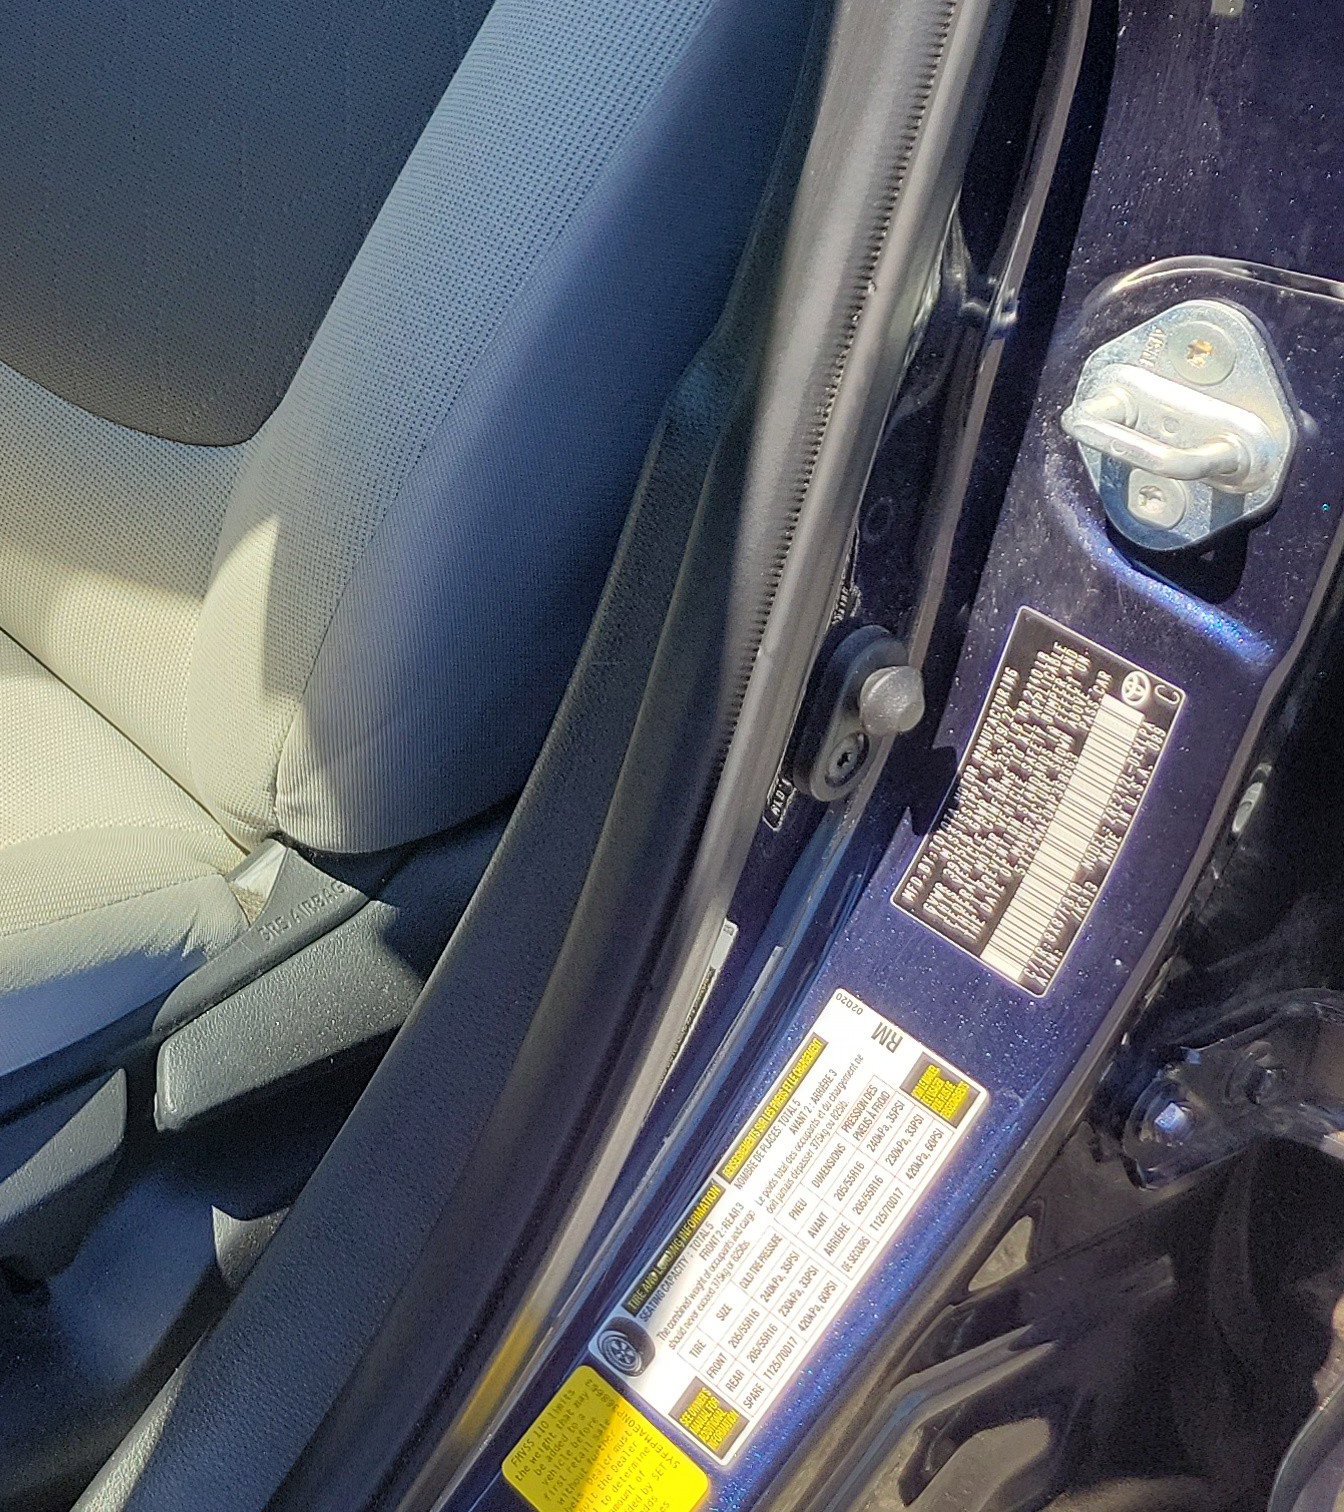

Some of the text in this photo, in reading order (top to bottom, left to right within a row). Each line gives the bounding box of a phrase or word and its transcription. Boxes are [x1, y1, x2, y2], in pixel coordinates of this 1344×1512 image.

[951, 762, 980, 805] MOTOR
[969, 664, 1019, 763] MANUFACTURING
[951, 640, 1067, 885] VEHICLE CONFORMS TO ALL APPLICABLE
[973, 831, 1000, 872] MOTOR
[995, 775, 1027, 829] VEHICLE
[1060, 647, 1078, 674] AND
[1016, 746, 1053, 814] STANDARDS
[939, 777, 986, 860] MISSISSIPPI
[963, 730, 1072, 941] THE DATE OF MANUFACTURE SHOWN
[1097, 830, 1121, 864] MADE
[1114, 808, 1131, 827] IN
[290, 882, 346, 924] AIRBAG
[921, 880, 947, 914] GVWR
[870, 1021, 904, 1053] RM
[754, 1194, 766, 1206] Le
[760, 1176, 780, 1199] poids
[773, 1161, 789, 1180] total
[783, 1148, 798, 1165] des
[792, 1116, 822, 1153] occupants
[820, 1099, 832, 1112] du
[826, 1061, 860, 1103] chargement
[787, 1110, 809, 1136] AVANT
[840, 1083, 878, 1133] PRESSION DES
[851, 1115, 873, 1141] PNEUS
[870, 1089, 891, 1113] FROID
[923, 1127, 945, 1152] 60PSI
[733, 1102, 798, 1190] NOMBRE DE TOTAL
[806, 1211, 829, 1239] AVANT
[832, 1160, 866, 1202] 205/55R16
[884, 1098, 906, 1124] 35PSI
[851, 1174, 884, 1215] 205/55R16
[903, 1112, 925, 1137] 33PSI
[764, 1197, 779, 1215] doit
[773, 1176, 796, 1203] jamais
[787, 1141, 847, 1221] PNEU DIMENSIONS
[627, 1183, 721, 1311] TIRE INFORMATION
[698, 1205, 741, 1262] FRONT REAR
[738, 1208, 757, 1231] cargo
[639, 1225, 711, 1323] SEATING CAPACITY TOTAL
[700, 1266, 713, 1279] of
[706, 1236, 736, 1274] occupants
[664, 1295, 692, 1330] combined
[667, 1325, 687, 1350] should
[682, 1308, 700, 1330] never
[694, 1285, 716, 1312] exceed
[685, 1274, 708, 1302] weight
[688, 1232, 783, 1359] TIRE SIZE COLD TIRE PRESSURE
[705, 1351, 728, 1379] FRONT
[727, 1306, 760, 1349] 205/55R16
[779, 1249, 800, 1274] 35PSI
[656, 1324, 671, 1342] The
[725, 1368, 745, 1392] REAR
[745, 1321, 779, 1364] 205/55R16
[797, 1264, 819, 1289] 33PSI
[742, 1381, 765, 1410] SPARE
[762, 1335, 799, 1381] T125/70D17
[816, 1279, 838, 1304] 60PSI
[514, 1389, 590, 1483] the weight that may
[533, 1419, 579, 1477] be added to
[540, 1414, 599, 1488] vehicle before
[542, 1472, 567, 1503] first
[565, 1439, 593, 1475] retail
[610, 1443, 650, 1495] determine
[650, 1460, 668, 1481] SET
